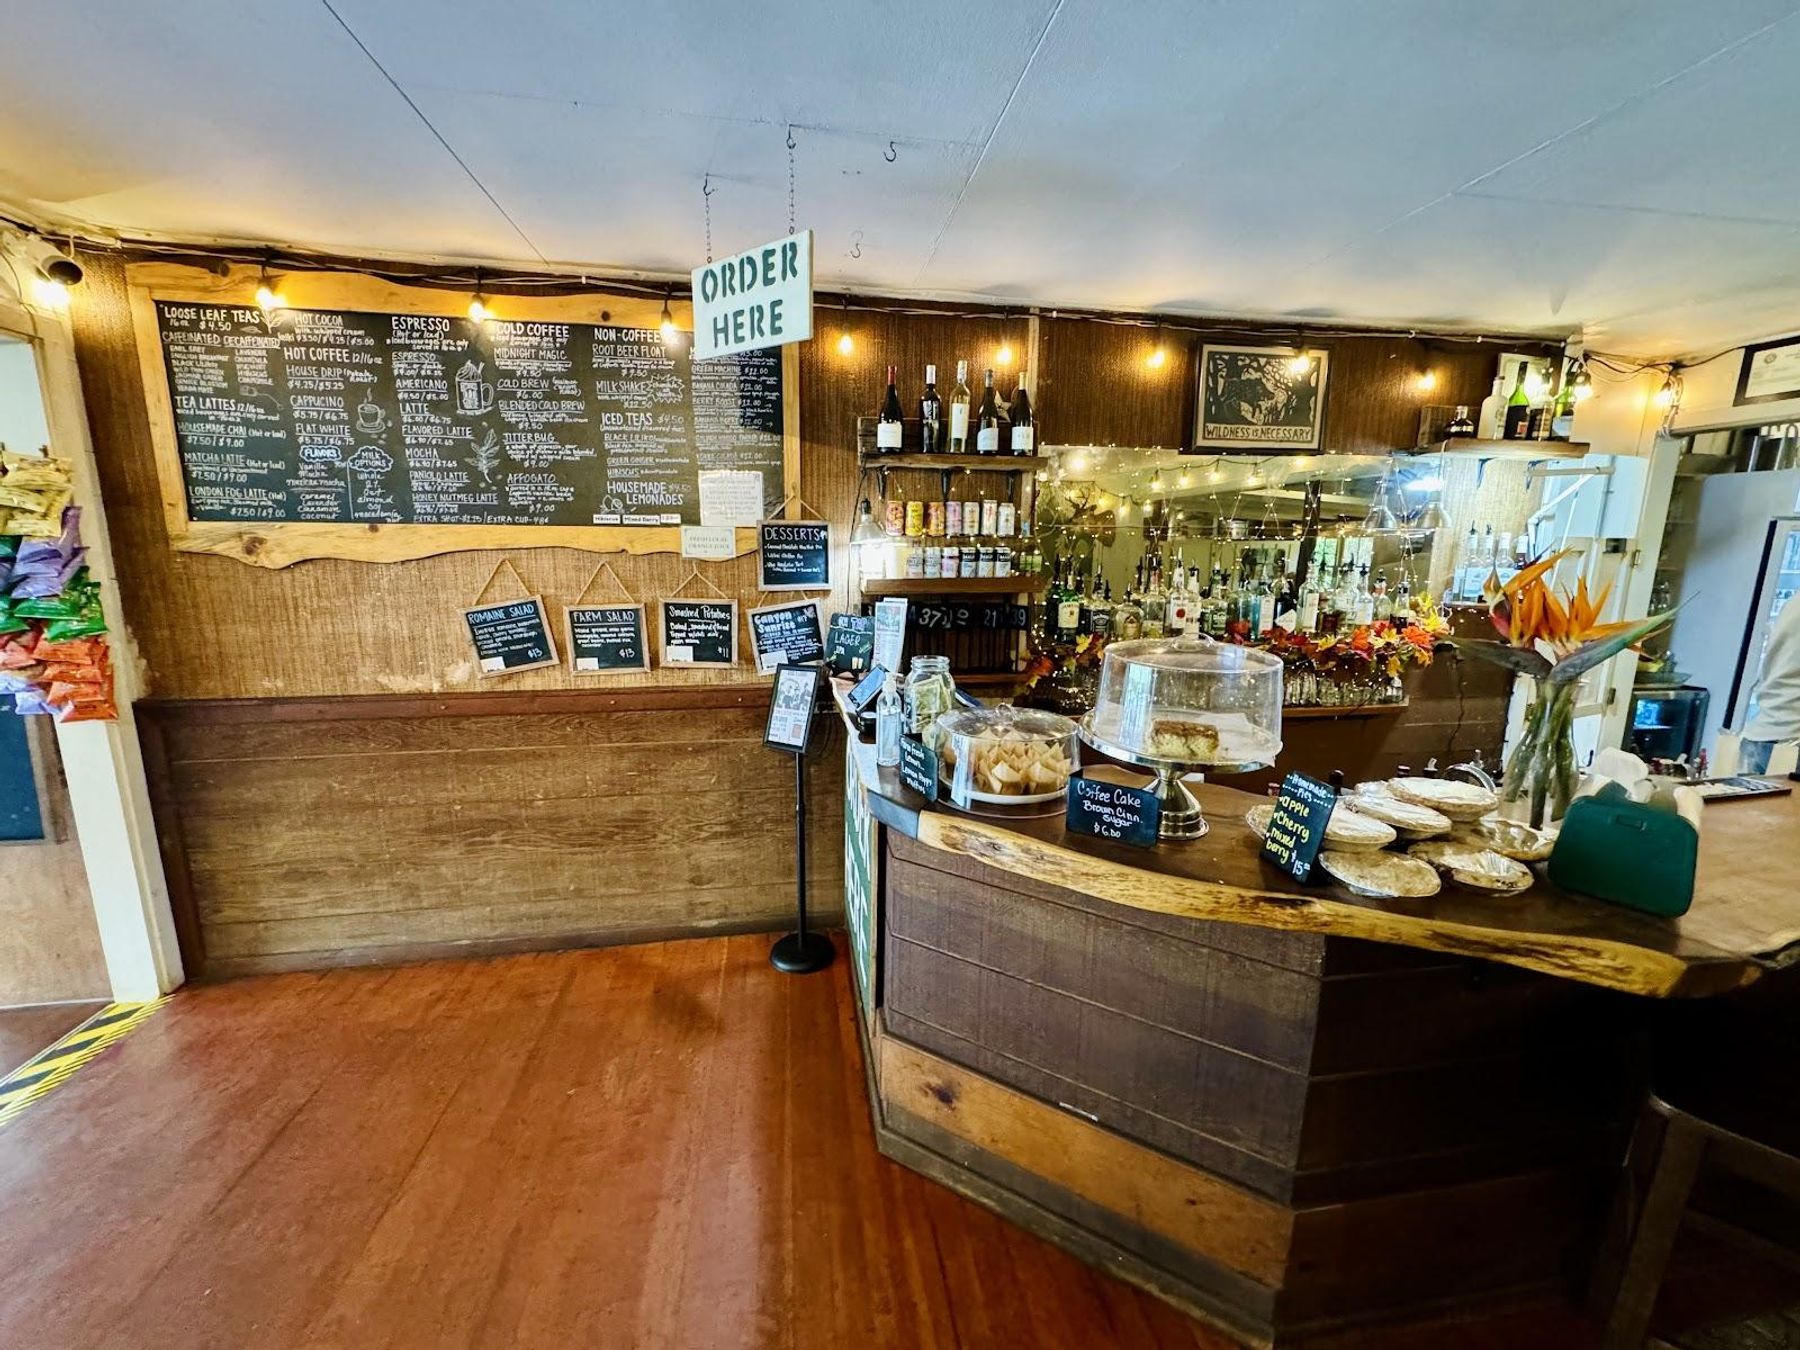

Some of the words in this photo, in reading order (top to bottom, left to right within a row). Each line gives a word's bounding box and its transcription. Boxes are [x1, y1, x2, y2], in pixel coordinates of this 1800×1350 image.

[701, 241, 798, 304] ORDER
[164, 306, 197, 320] LOOSE
[200, 308, 227, 321] LEAF
[231, 310, 260, 323] TEAS
[294, 313, 313, 326] HOT
[315, 314, 344, 327] COCOA
[391, 316, 450, 332] ESPRESSO
[496, 322, 524, 335] COLD
[527, 323, 570, 338] COFFEE
[713, 299, 784, 349] HERE
[162, 331, 220, 344] CAFFEINATED
[223, 335, 280, 348] DECAFFEINATED
[594, 327, 662, 344] NON-COFFEE
[284, 346, 307, 360] HOT
[309, 347, 351, 363] COFFEE
[391, 351, 437, 362] ESPRESSO
[494, 347, 537, 360] MIDNIGHT
[538, 349, 568, 361] MAGIC
[592, 343, 614, 356] ROOT
[617, 345, 639, 358] BEER
[641, 346, 667, 359] FLOAT
[286, 364, 319, 378] HOUSE
[321, 368, 343, 379] DRIP
[396, 378, 448, 389] AMERICANO
[497, 378, 519, 389] COLD
[521, 379, 550, 389] BREW
[174, 396, 197, 409] TEA
[200, 397, 236, 411] LATTES
[290, 395, 344, 408] CAPPUCINO
[400, 403, 429, 414] LATTE
[499, 400, 537, 411] BLENDED
[538, 400, 559, 411] COLD
[561, 400, 585, 411] BREW
[601, 411, 623, 426] ICED
[626, 412, 653, 426] TEAS
[177, 421, 226, 434] HOUSEMADE
[227, 425, 247, 436] CHAI
[296, 423, 317, 435] FLAT
[320, 424, 351, 436] WHITE
[401, 424, 444, 436] FLAVORED
[446, 426, 473, 437] LATTE
[1206, 425, 1251, 439] WILDNESS
[1260, 428, 1312, 441] NECESSARY
[184, 452, 219, 463] MATCHA
[220, 453, 246, 465] LATTE
[361, 451, 381, 460] MILK
[404, 447, 440, 459] MOCHA
[354, 459, 386, 468] OPTIONS
[444, 471, 470, 482] LATTE
[507, 472, 556, 484] AFFOGATO
[189, 486, 223, 498] LONDON
[224, 487, 242, 498] FOG
[244, 488, 268, 500] LATTE
[412, 492, 438, 502] HONEY
[440, 493, 474, 503] NUTMEG
[476, 493, 499, 504] LATTE
[626, 493, 685, 505] LEMONADES
[764, 526, 820, 542] DESSERTS
[466, 608, 506, 625] ROMAINE
[509, 603, 535, 618] SALAD
[573, 610, 602, 623] FARM
[606, 610, 635, 623] SALAD
[669, 605, 700, 619] Smashed
[700, 605, 731, 620] Potatoes
[754, 611, 793, 625] Canyon
[758, 620, 796, 634] Sunrise
[527, 647, 543, 660] $13
[619, 647, 636, 659] $13
[1077, 780, 1111, 803] Coffee
[1113, 789, 1142, 807] Cake
[1083, 799, 1115, 816] Brown
[1115, 807, 1144, 824] Cinn.
[1266, 838, 1290, 865] berry
